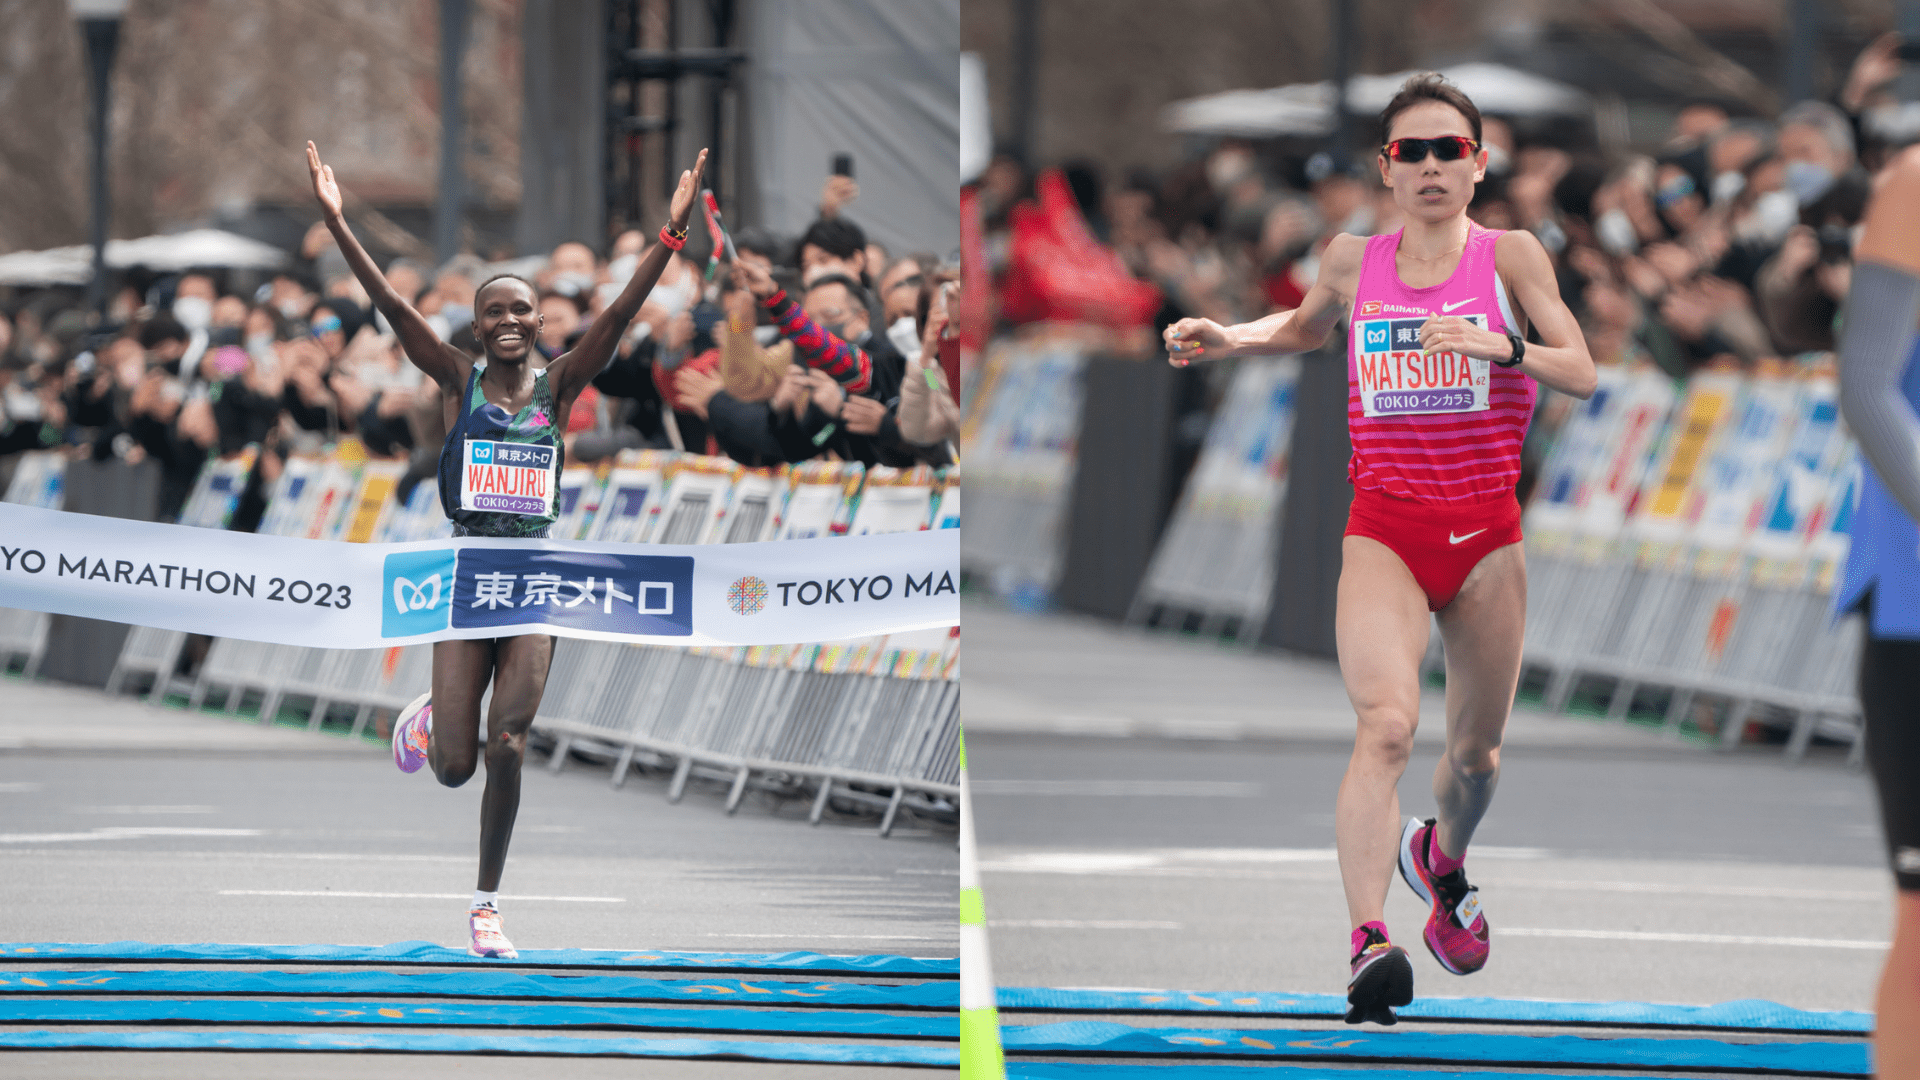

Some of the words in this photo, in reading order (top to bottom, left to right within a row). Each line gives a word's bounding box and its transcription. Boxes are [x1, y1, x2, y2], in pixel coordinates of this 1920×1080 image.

[1383, 304, 1428, 315] DAIHATSU
[1360, 351, 1473, 392] MATSUDA
[1476, 376, 1486, 386] 62
[497, 449, 550, 464] 東京メトロ
[468, 465, 546, 498] WANJIRU
[0, 546, 46, 574] YO
[58, 553, 256, 598] MARATHON
[267, 578, 352, 610] 2023
[471, 571, 674, 615] 東京メトロ
[777, 574, 893, 607] TOKYO
